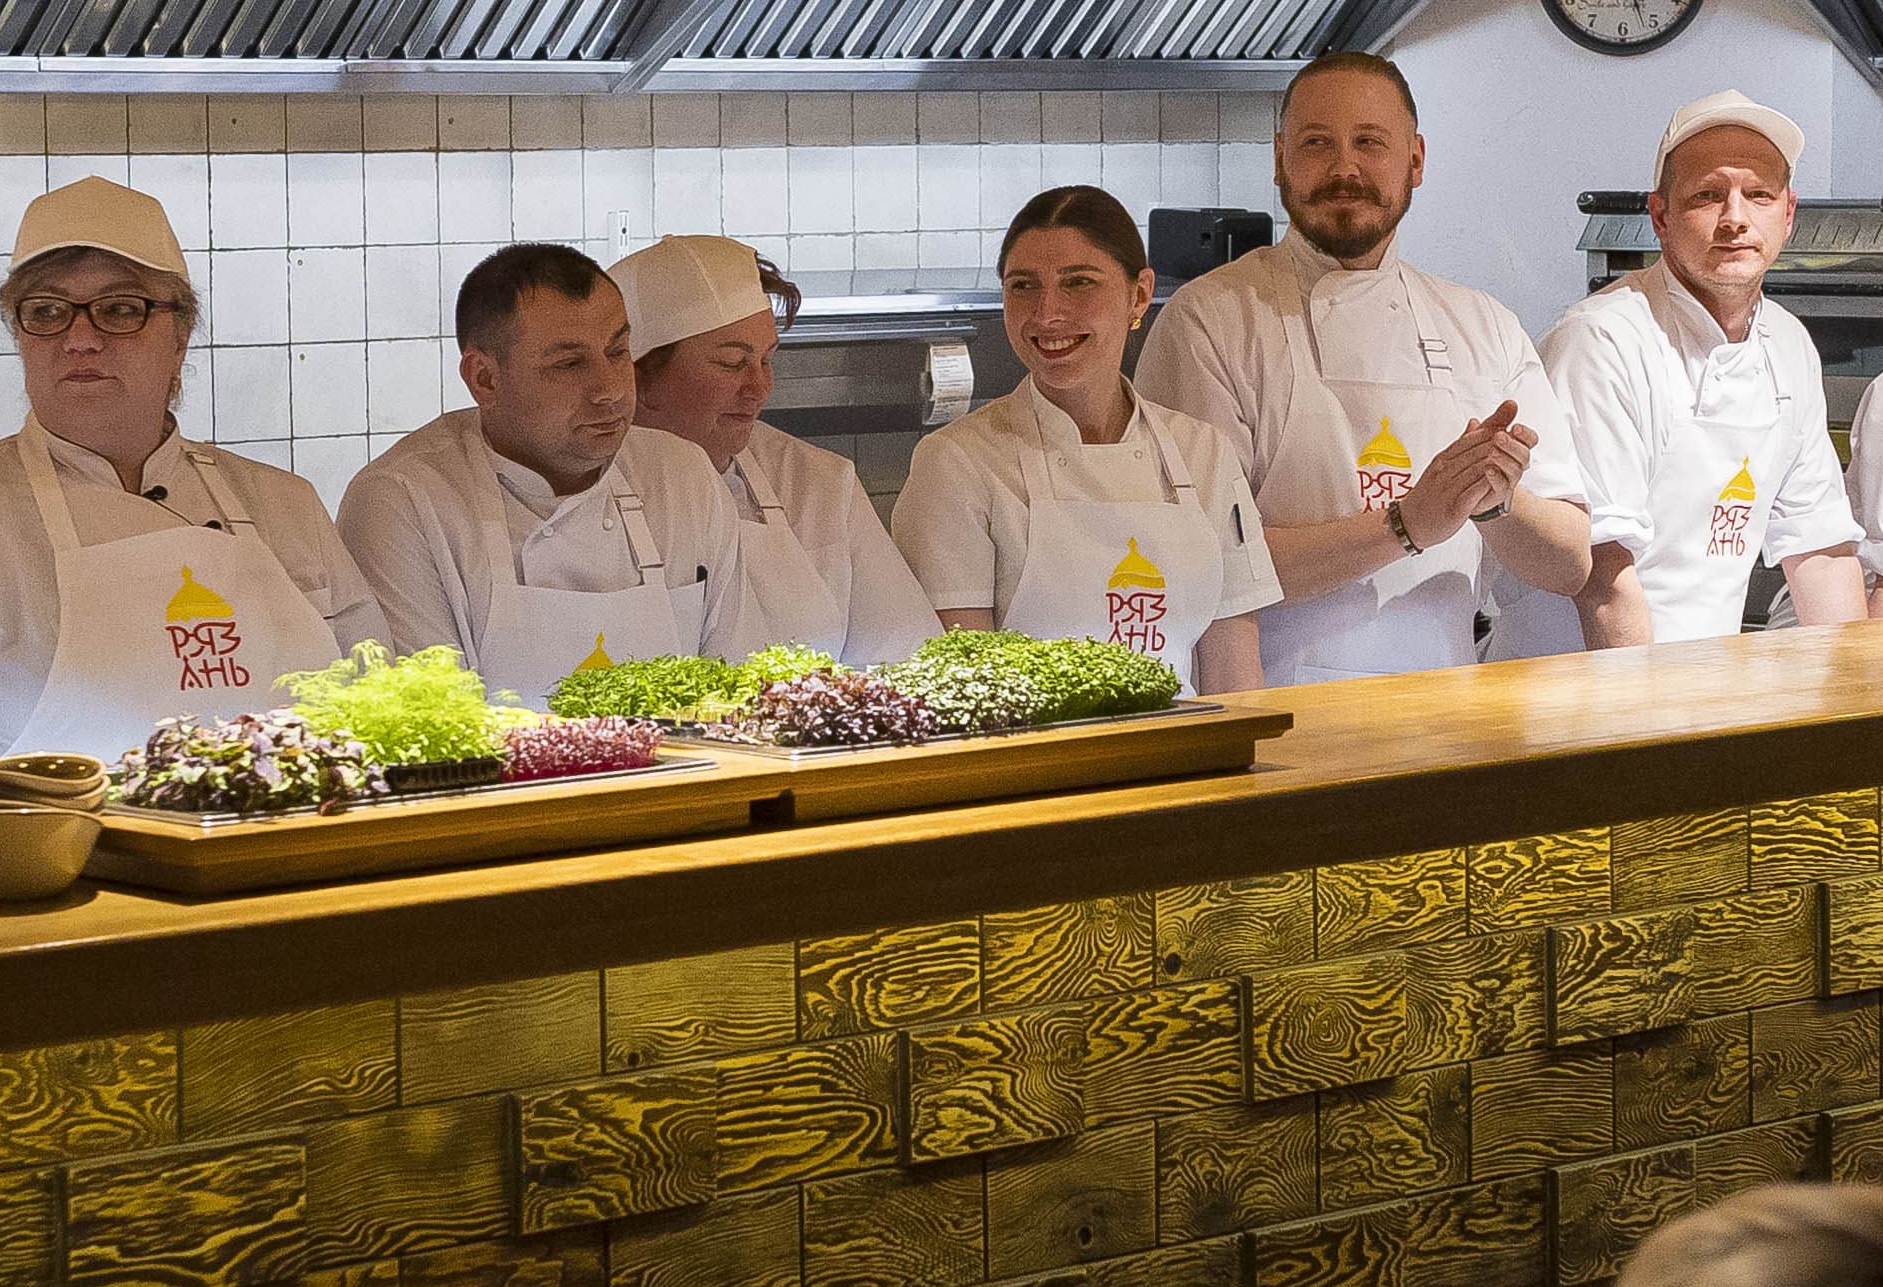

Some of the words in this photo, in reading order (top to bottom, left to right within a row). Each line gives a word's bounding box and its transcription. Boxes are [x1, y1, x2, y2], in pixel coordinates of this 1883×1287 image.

[1588, 13, 1598, 28] 7
[1618, 22, 1629, 37] 6
[1648, 14, 1659, 29] 5
[1105, 592, 1168, 624] РЯЗ
[165, 621, 242, 659] РЯЗ
[180, 655, 251, 691] АНЬ
